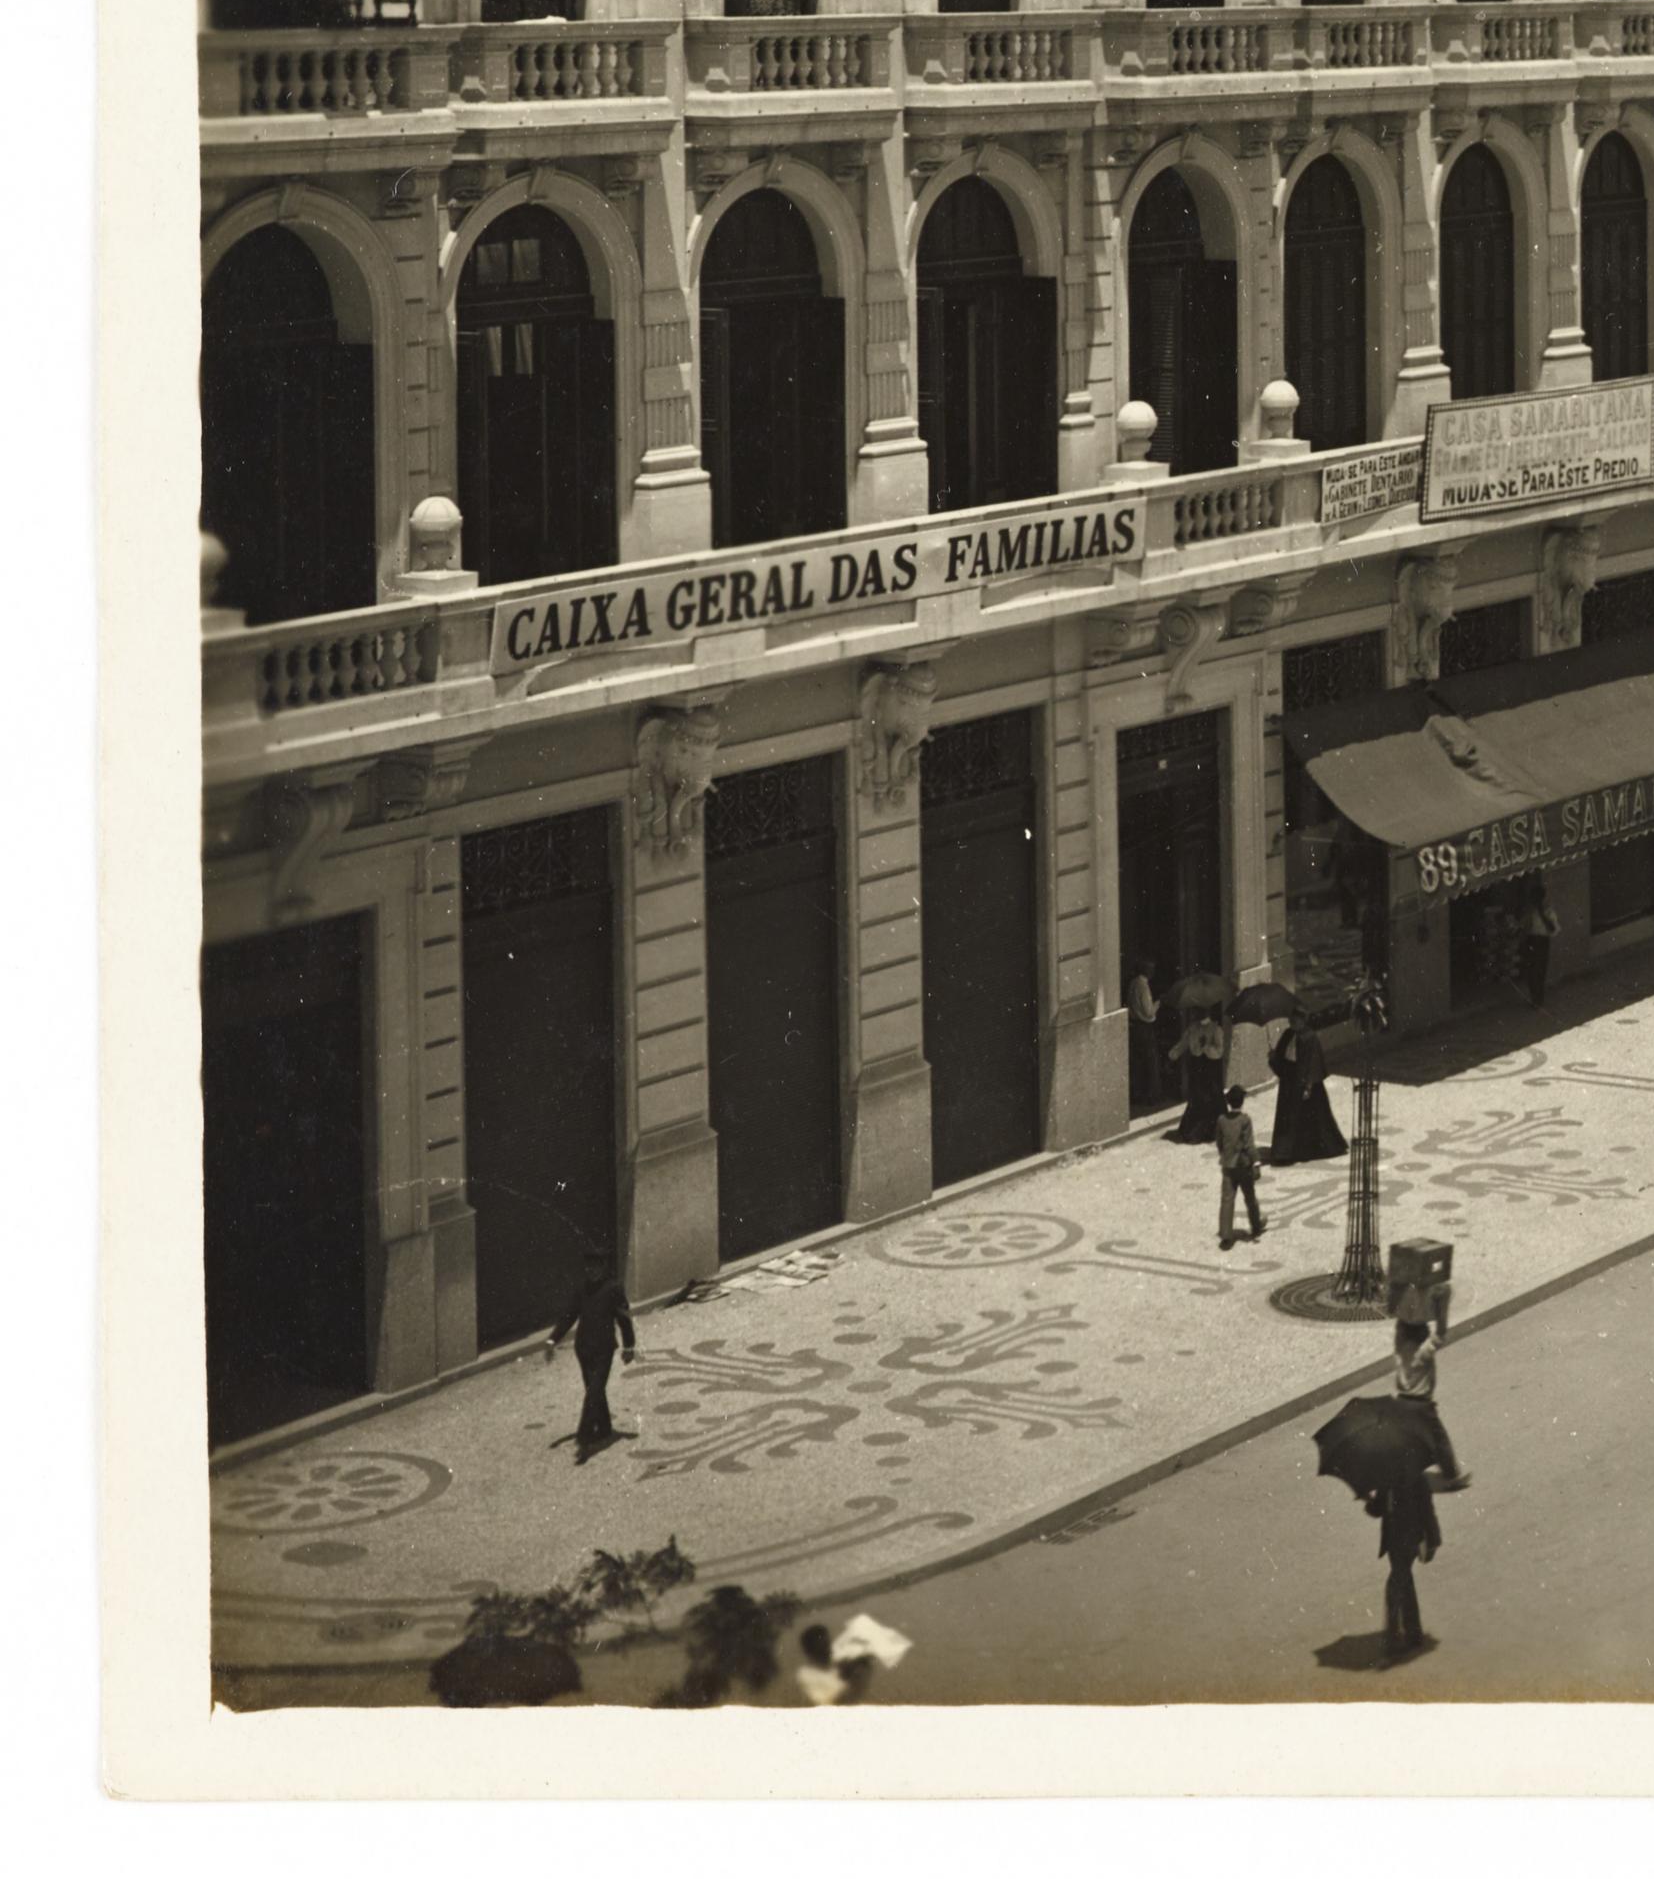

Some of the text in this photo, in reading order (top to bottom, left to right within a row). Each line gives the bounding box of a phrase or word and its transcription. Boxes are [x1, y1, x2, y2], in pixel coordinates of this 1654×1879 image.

[1441, 387, 1648, 446] CASA SAMARITANA
[1521, 469, 1556, 495] PARA
[1557, 462, 1591, 488] ESTE
[1593, 456, 1640, 481] PREDIO
[507, 508, 1137, 661] CAIXA GERAL DAS FAMILIAS
[1466, 810, 1551, 878] CASA
